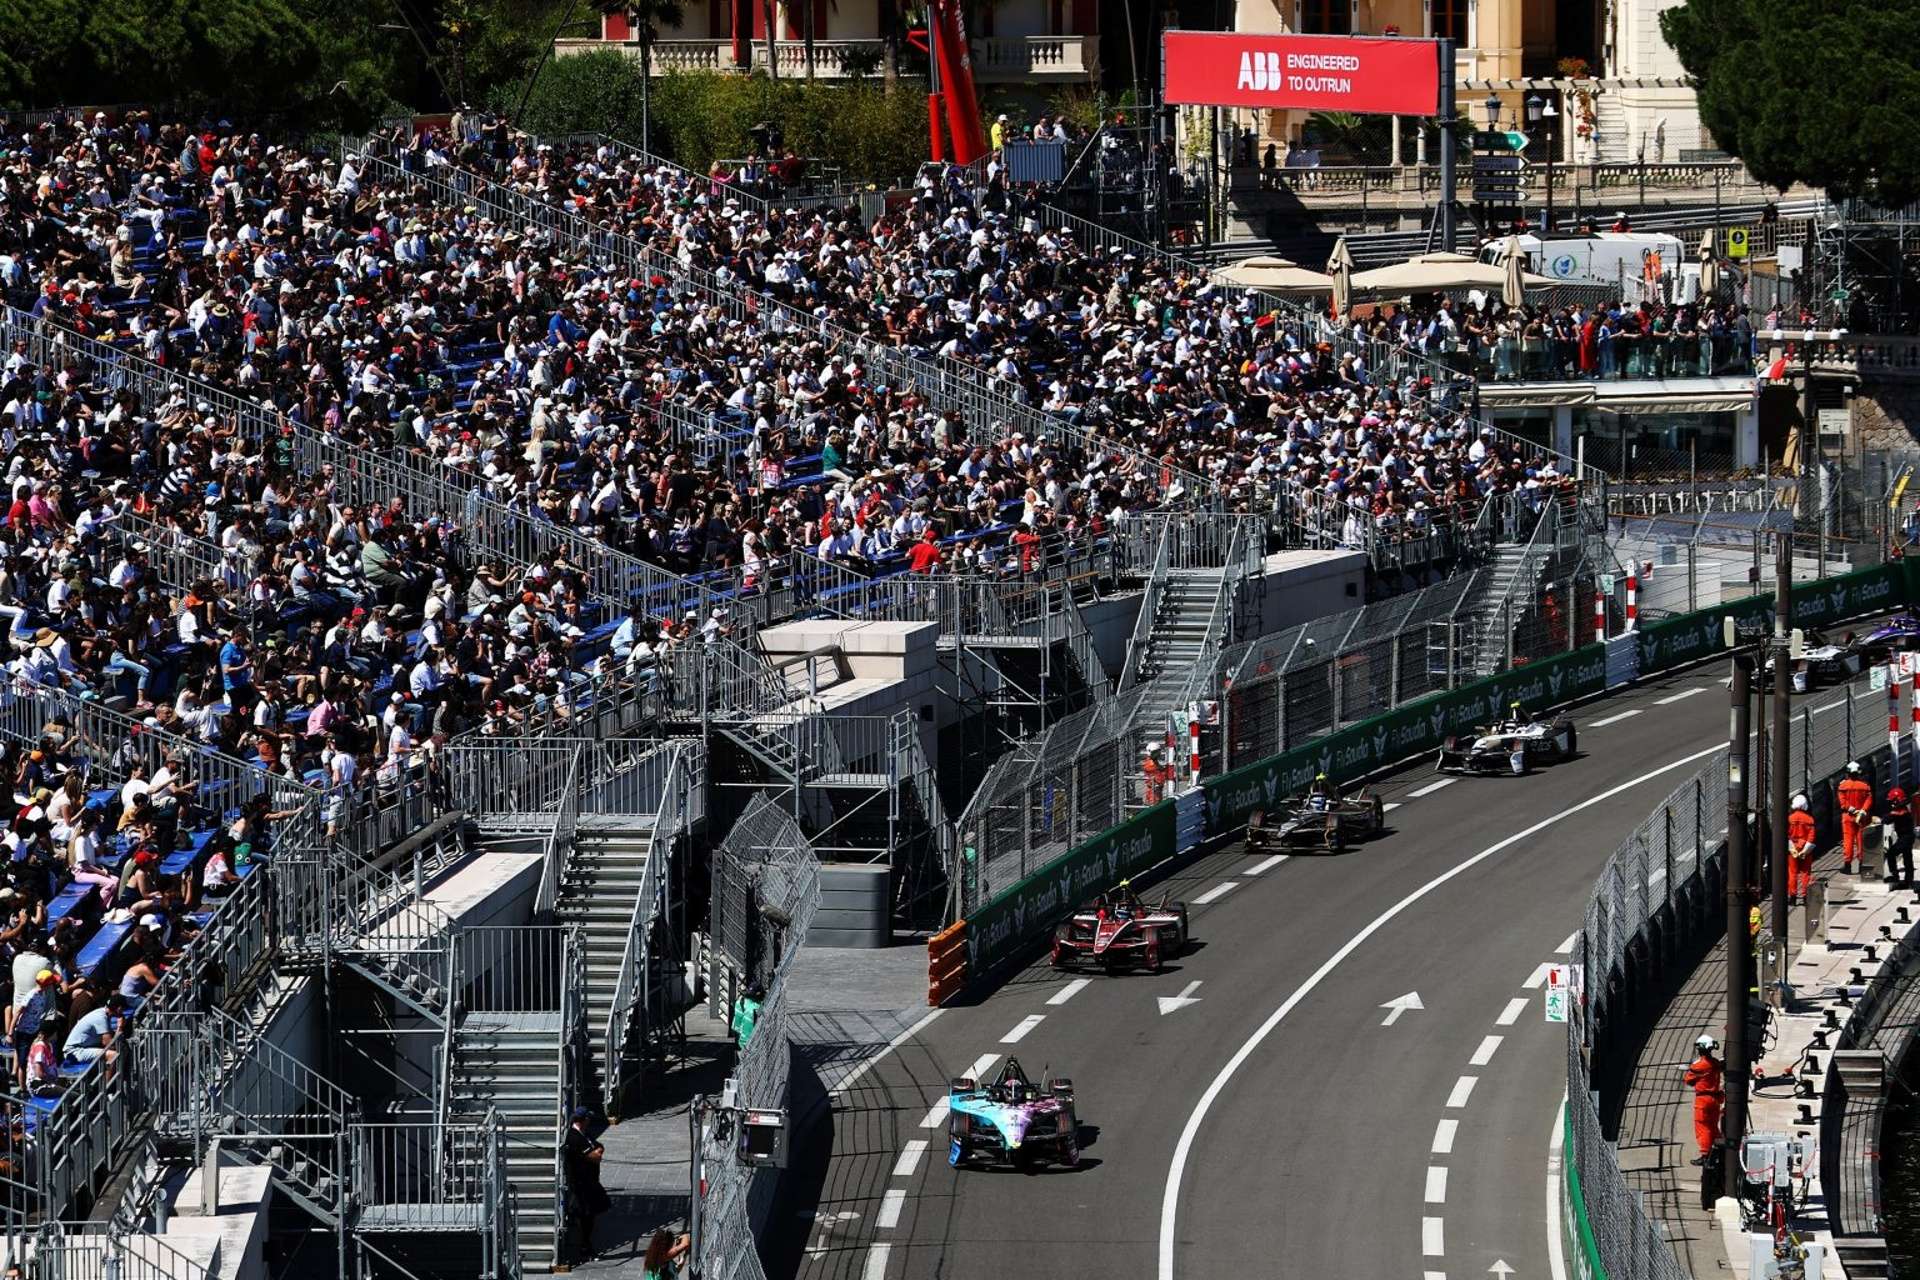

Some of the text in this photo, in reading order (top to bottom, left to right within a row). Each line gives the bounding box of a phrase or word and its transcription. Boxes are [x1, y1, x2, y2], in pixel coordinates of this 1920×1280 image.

[1237, 51, 1281, 91] ABB
[1287, 54, 1360, 71] ENGINEERED
[1288, 76, 1351, 93] TO OUTRUN
